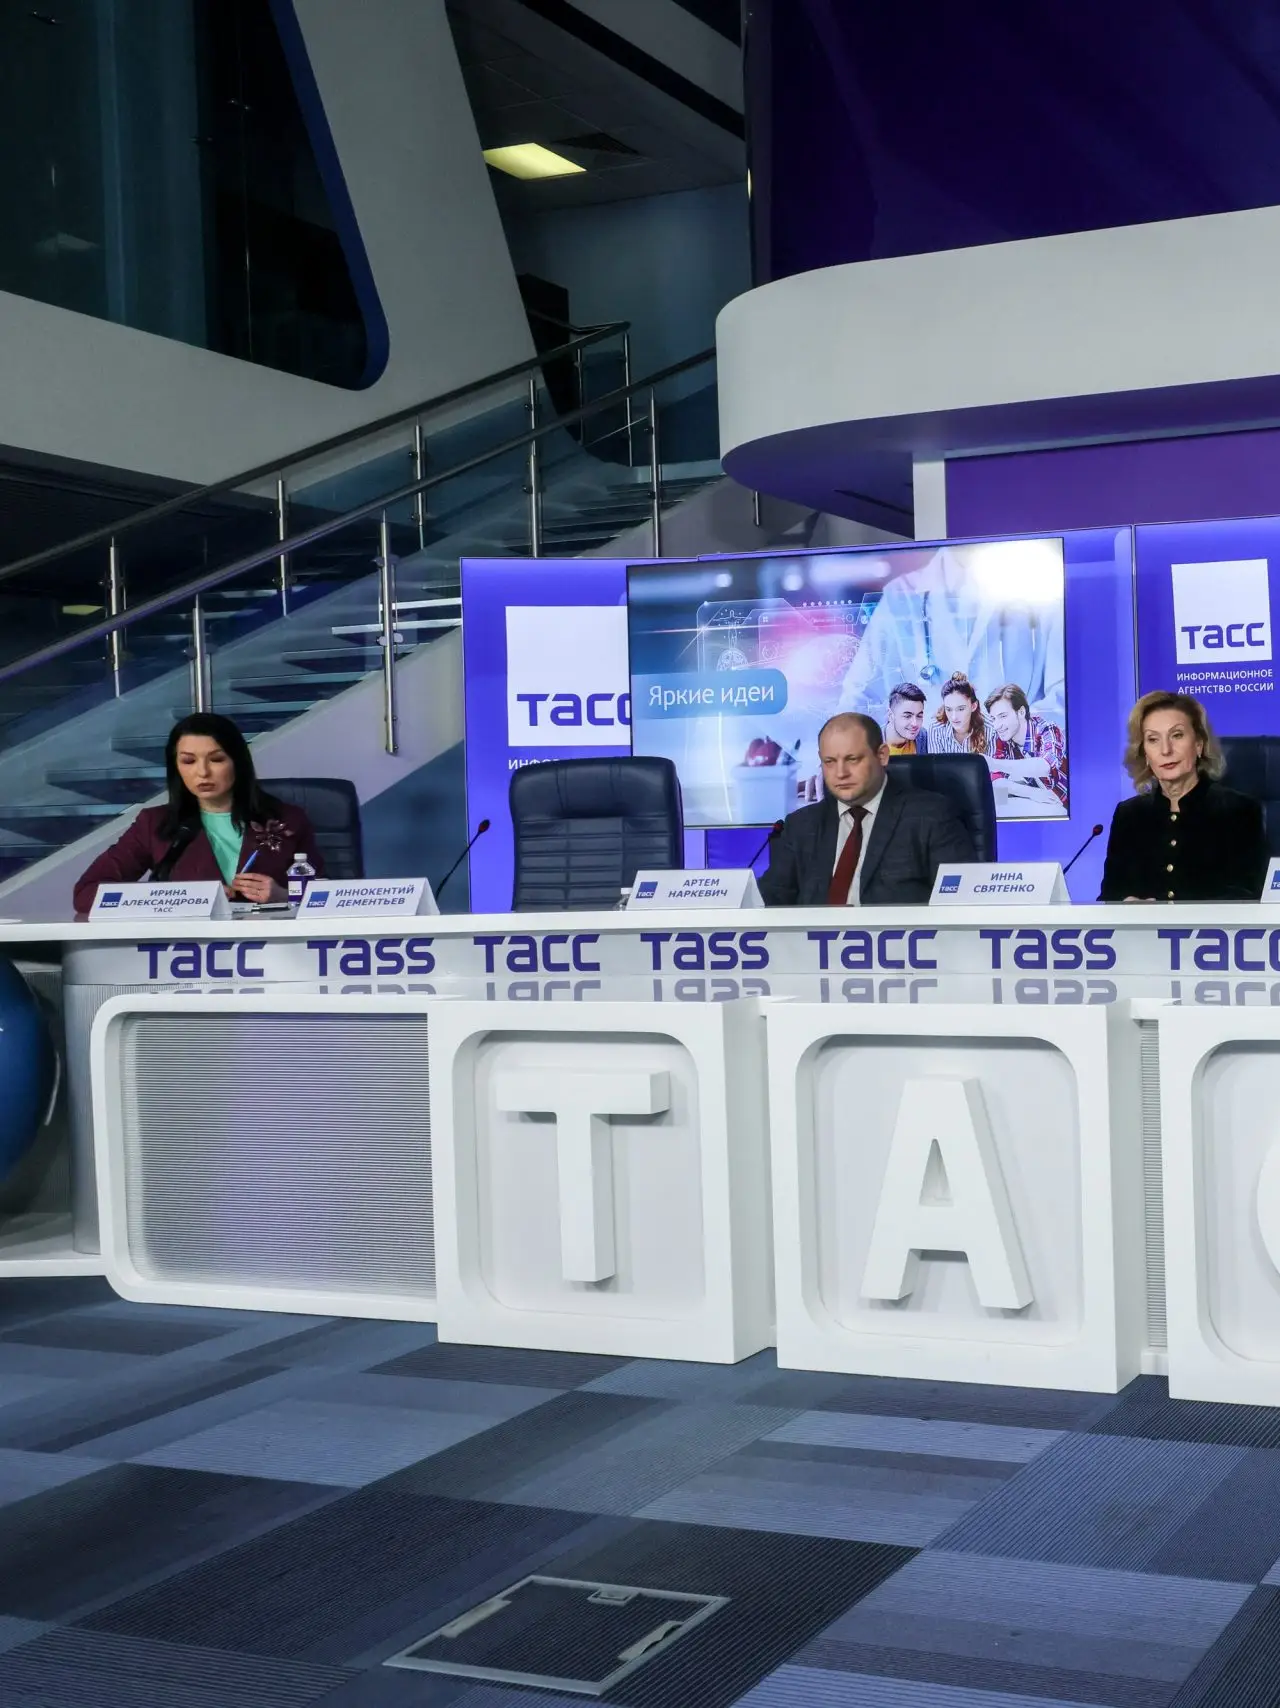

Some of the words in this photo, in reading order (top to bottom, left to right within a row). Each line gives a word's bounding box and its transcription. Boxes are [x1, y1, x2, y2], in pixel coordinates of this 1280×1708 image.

[1176, 668, 1273, 682] ИНФОРМАЦИОННОЕ
[1177, 684, 1232, 695] АГЕНТСТВО
[1234, 682, 1274, 692] РОССИИ
[649, 685, 715, 711] Яркие
[719, 684, 775, 707] идеи
[990, 872, 1023, 881] ИННА
[683, 878, 720, 887] АРТЕМ
[335, 884, 415, 897] ИННОКЕНТИЙ
[668, 889, 728, 898] НАРКЕВИЧ
[973, 884, 1035, 893] СВЯТЕНКО
[121, 898, 209, 906] АЛЕКСАНДРОВА
[336, 897, 405, 908] ДЕМЕНТЬЕВ
